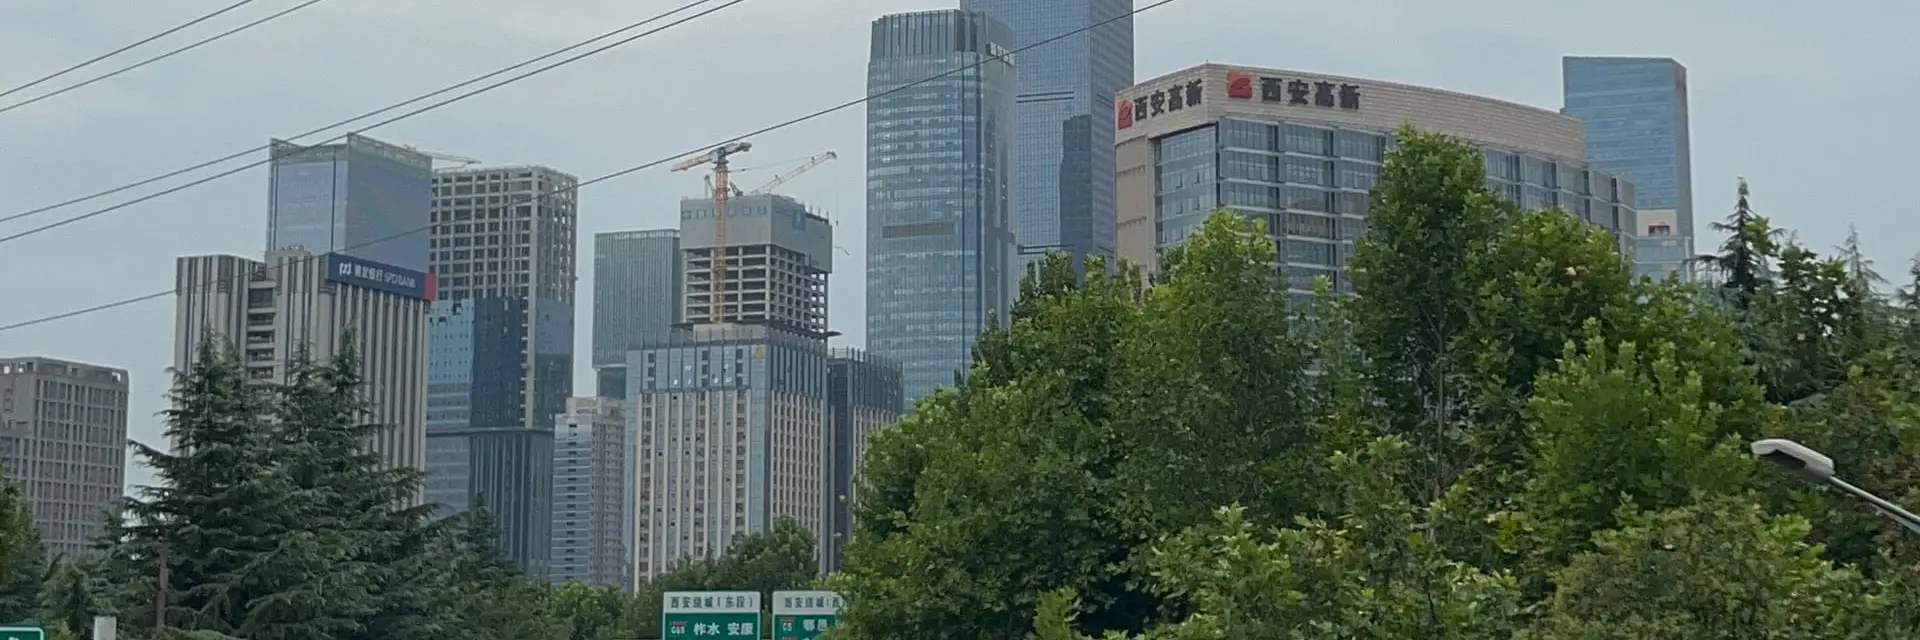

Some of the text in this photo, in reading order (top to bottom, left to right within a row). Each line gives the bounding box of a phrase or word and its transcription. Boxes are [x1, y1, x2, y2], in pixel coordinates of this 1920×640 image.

[1134, 79, 1203, 121] 西安高新
[1260, 77, 1360, 110] 西安高新
[693, 622, 720, 636] 柞水
[727, 622, 754, 636] 安康
